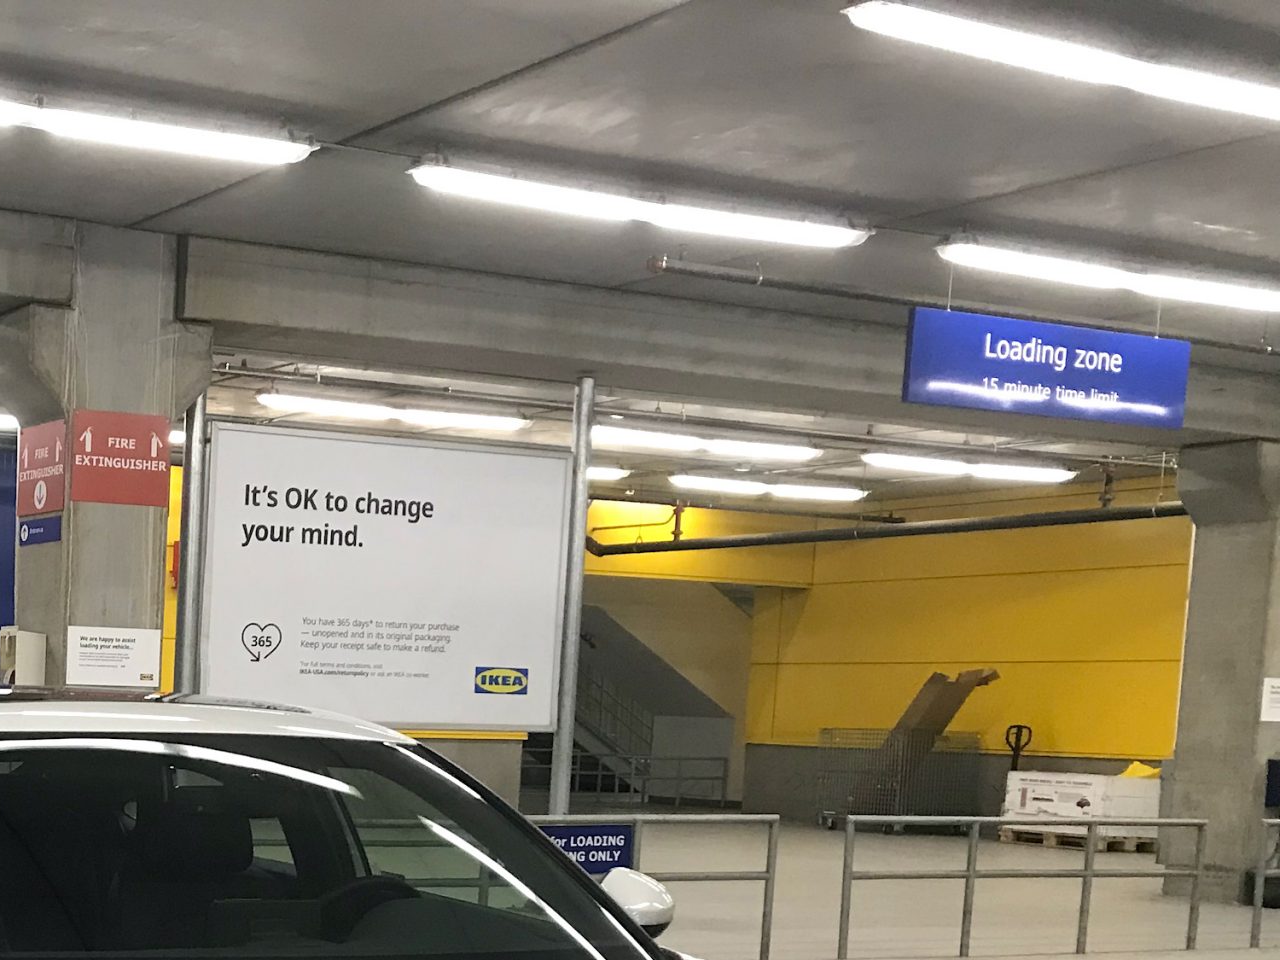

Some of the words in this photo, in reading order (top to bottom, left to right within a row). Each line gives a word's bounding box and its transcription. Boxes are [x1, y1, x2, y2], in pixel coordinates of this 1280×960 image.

[985, 332, 1067, 371] Loading
[1074, 348, 1123, 373] zone
[982, 376, 999, 392] 15
[1003, 380, 1051, 399] minute
[1055, 385, 1085, 401] time
[108, 437, 136, 450] FIRE
[34, 446, 49, 459] FIRE
[75, 454, 167, 472] EXTINGUISHER
[19, 464, 64, 482] EXTINGUISHER
[244, 484, 278, 508] It's
[285, 487, 318, 510] OK
[325, 491, 348, 512] to
[355, 492, 434, 524] change
[241, 523, 295, 547] your
[301, 523, 364, 547] mind.
[302, 617, 316, 626] You
[319, 617, 335, 626] have
[337, 618, 350, 627] 365
[375, 620, 384, 628] to
[385, 620, 407, 629] return
[409, 622, 426, 631] your
[428, 622, 460, 632] purchase
[252, 635, 272, 648] 365
[312, 630, 348, 638] unopened
[351, 631, 364, 639] and
[386, 632, 413, 642] original
[300, 640, 319, 650] Keep
[321, 642, 338, 651] your
[340, 642, 364, 651] receipt
[366, 642, 382, 651] safe
[383, 643, 392, 651] to
[393, 643, 413, 652] make
[480, 673, 524, 687] IKEA
[570, 835, 625, 847] LOADING
[589, 850, 621, 862] ONLY
